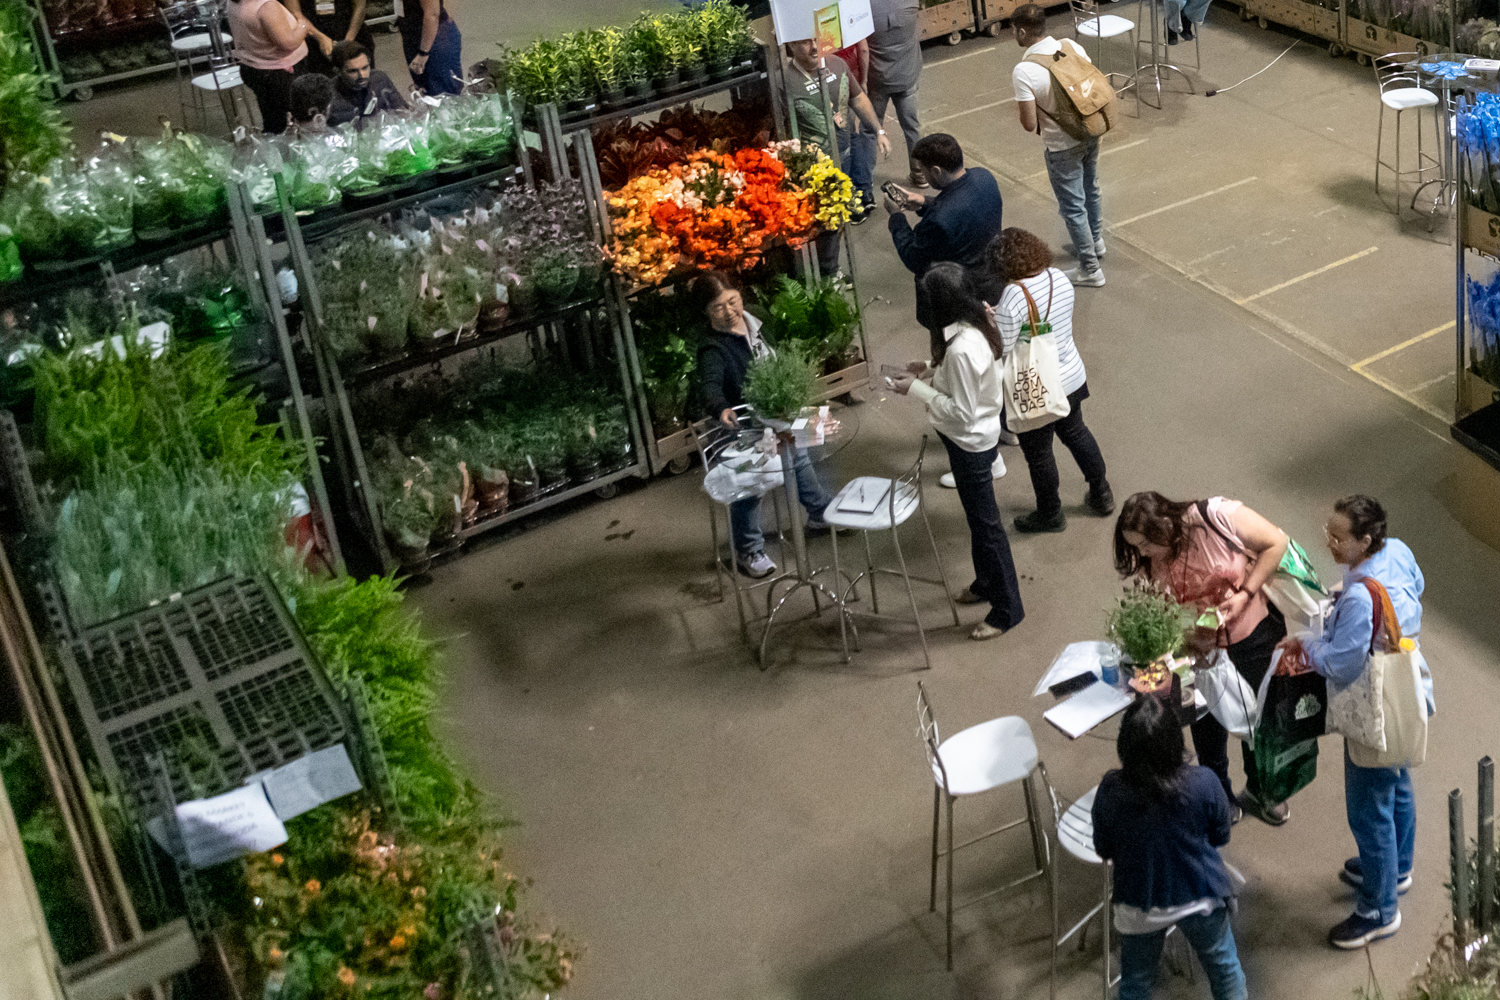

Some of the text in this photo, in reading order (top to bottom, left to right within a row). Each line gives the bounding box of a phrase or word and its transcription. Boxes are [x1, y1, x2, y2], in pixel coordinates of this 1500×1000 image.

[1017, 367, 1037, 382] DES
[1014, 375, 1042, 392] COM
[1012, 385, 1049, 403] PLICA
[1019, 397, 1046, 413] DAS
